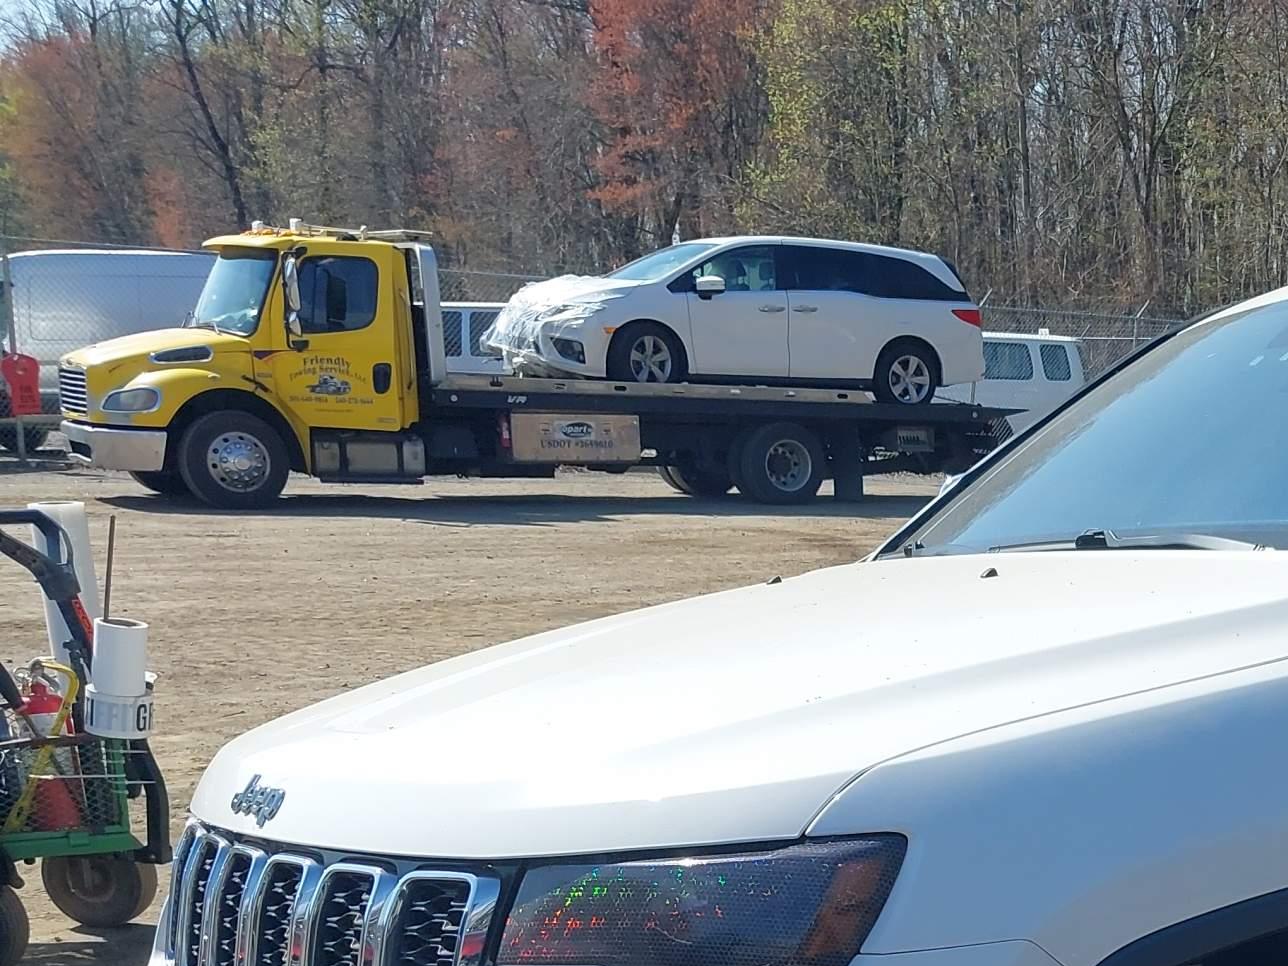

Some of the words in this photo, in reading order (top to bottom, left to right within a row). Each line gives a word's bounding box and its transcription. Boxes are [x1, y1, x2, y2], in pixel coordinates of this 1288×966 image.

[303, 355, 352, 369] Friendly
[507, 395, 528, 404] VR
[540, 439, 572, 448] USDOT
[231, 774, 286, 829] Jeep
